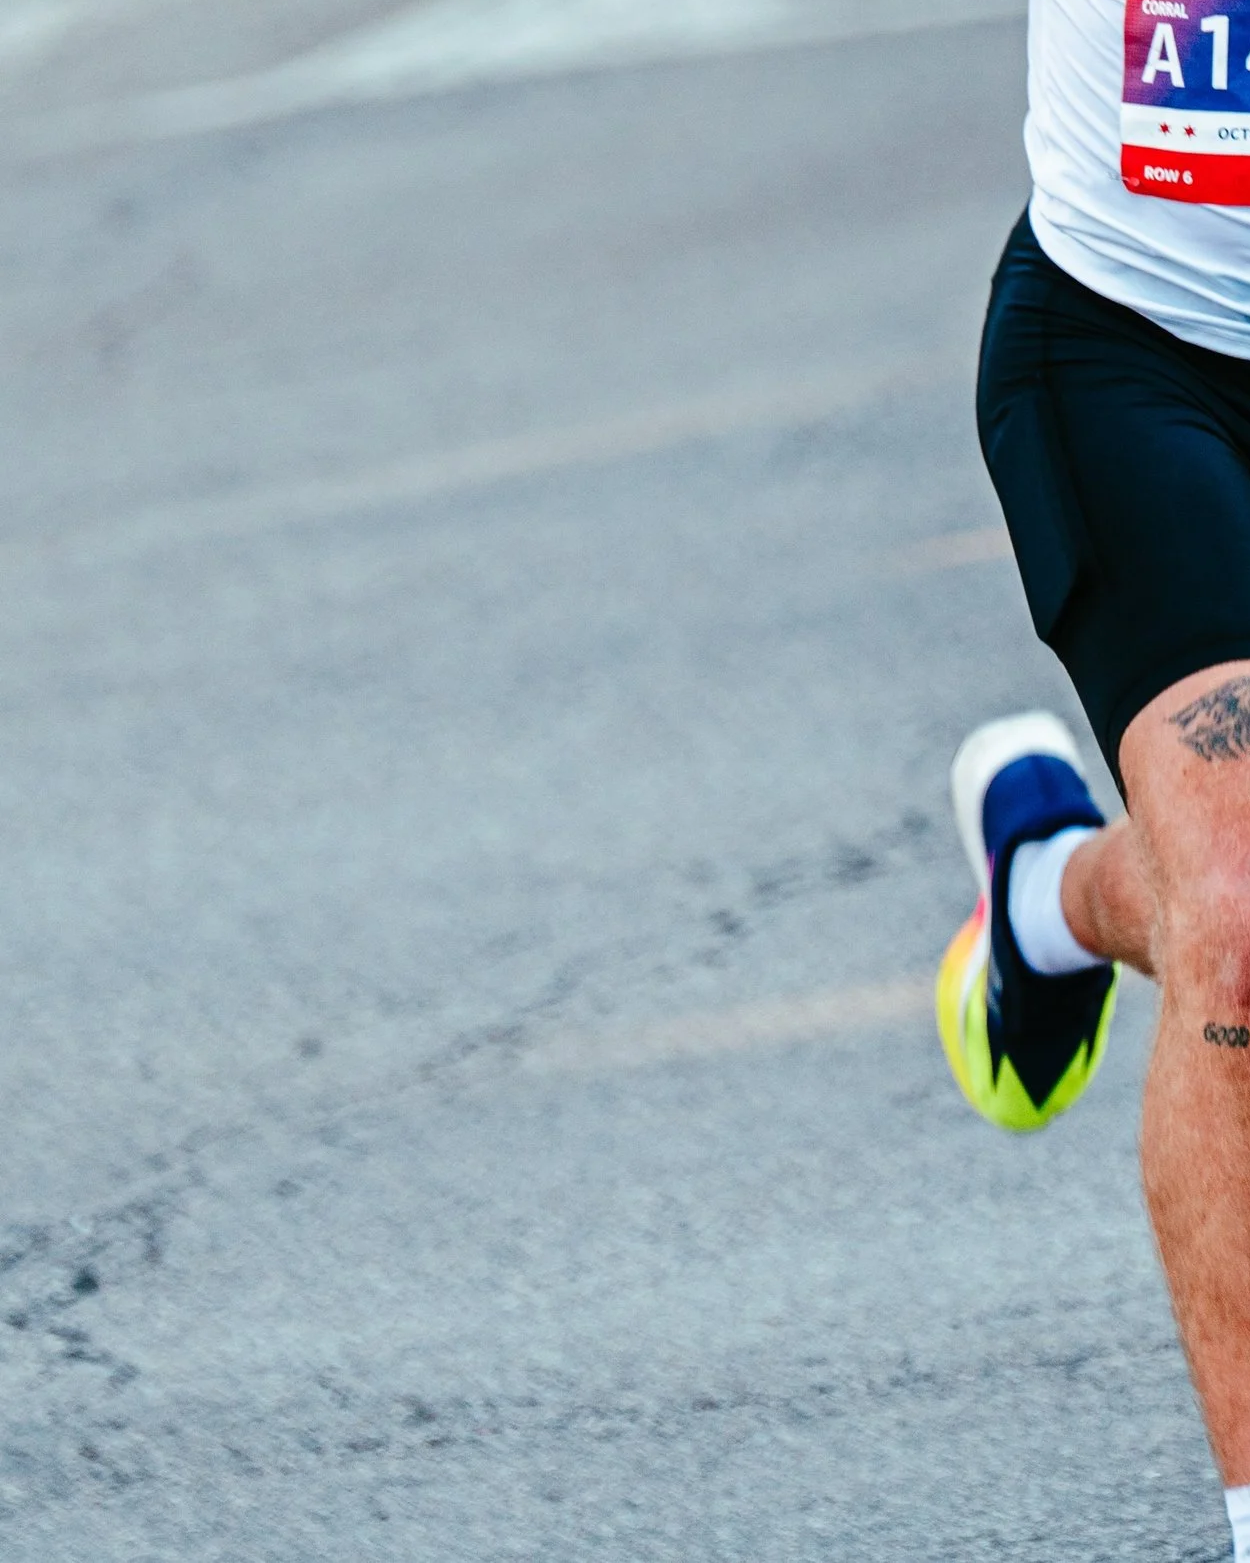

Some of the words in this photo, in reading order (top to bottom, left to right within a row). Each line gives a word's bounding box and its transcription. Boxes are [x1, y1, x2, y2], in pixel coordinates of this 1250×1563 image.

[1141, 22, 1185, 89] A
[1143, 164, 1180, 184] ROW
[1182, 170, 1194, 185] 6
